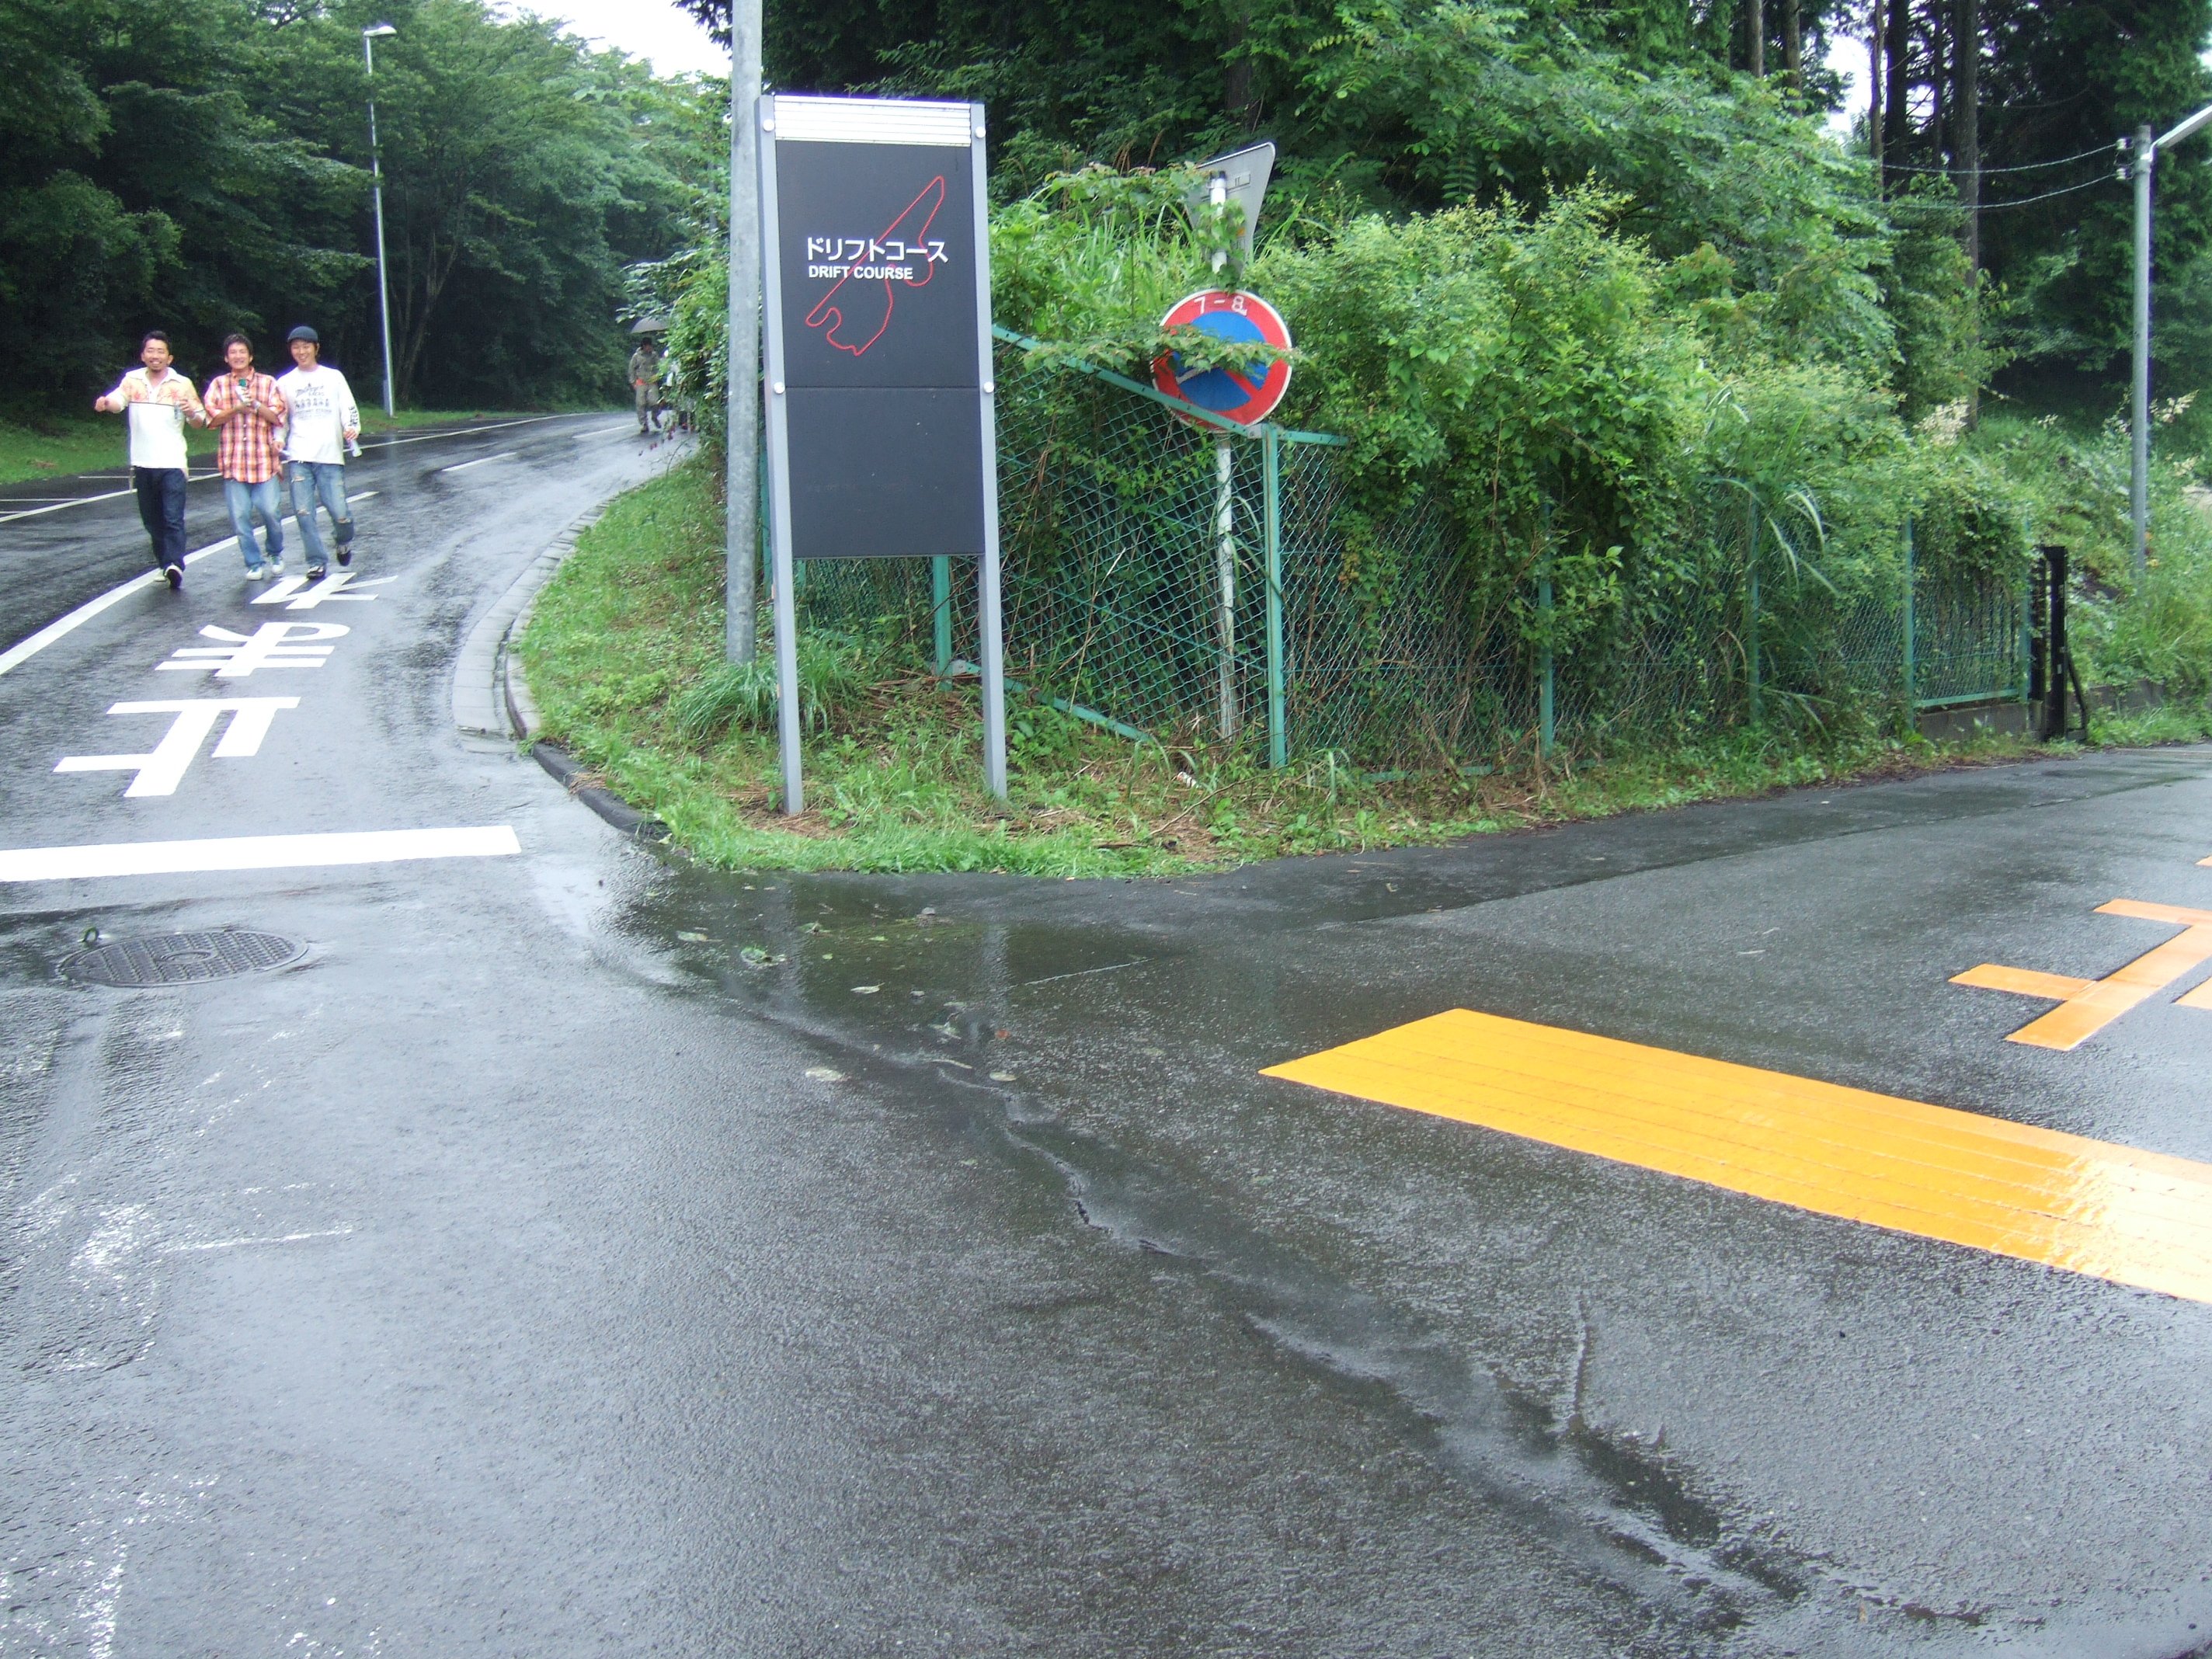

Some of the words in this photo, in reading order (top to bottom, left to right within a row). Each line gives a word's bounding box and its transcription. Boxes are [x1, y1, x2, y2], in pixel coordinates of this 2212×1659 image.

[807, 236, 949, 263] ドリフトコース
[808, 264, 850, 279] DRIFT
[854, 266, 913, 280] COURSE
